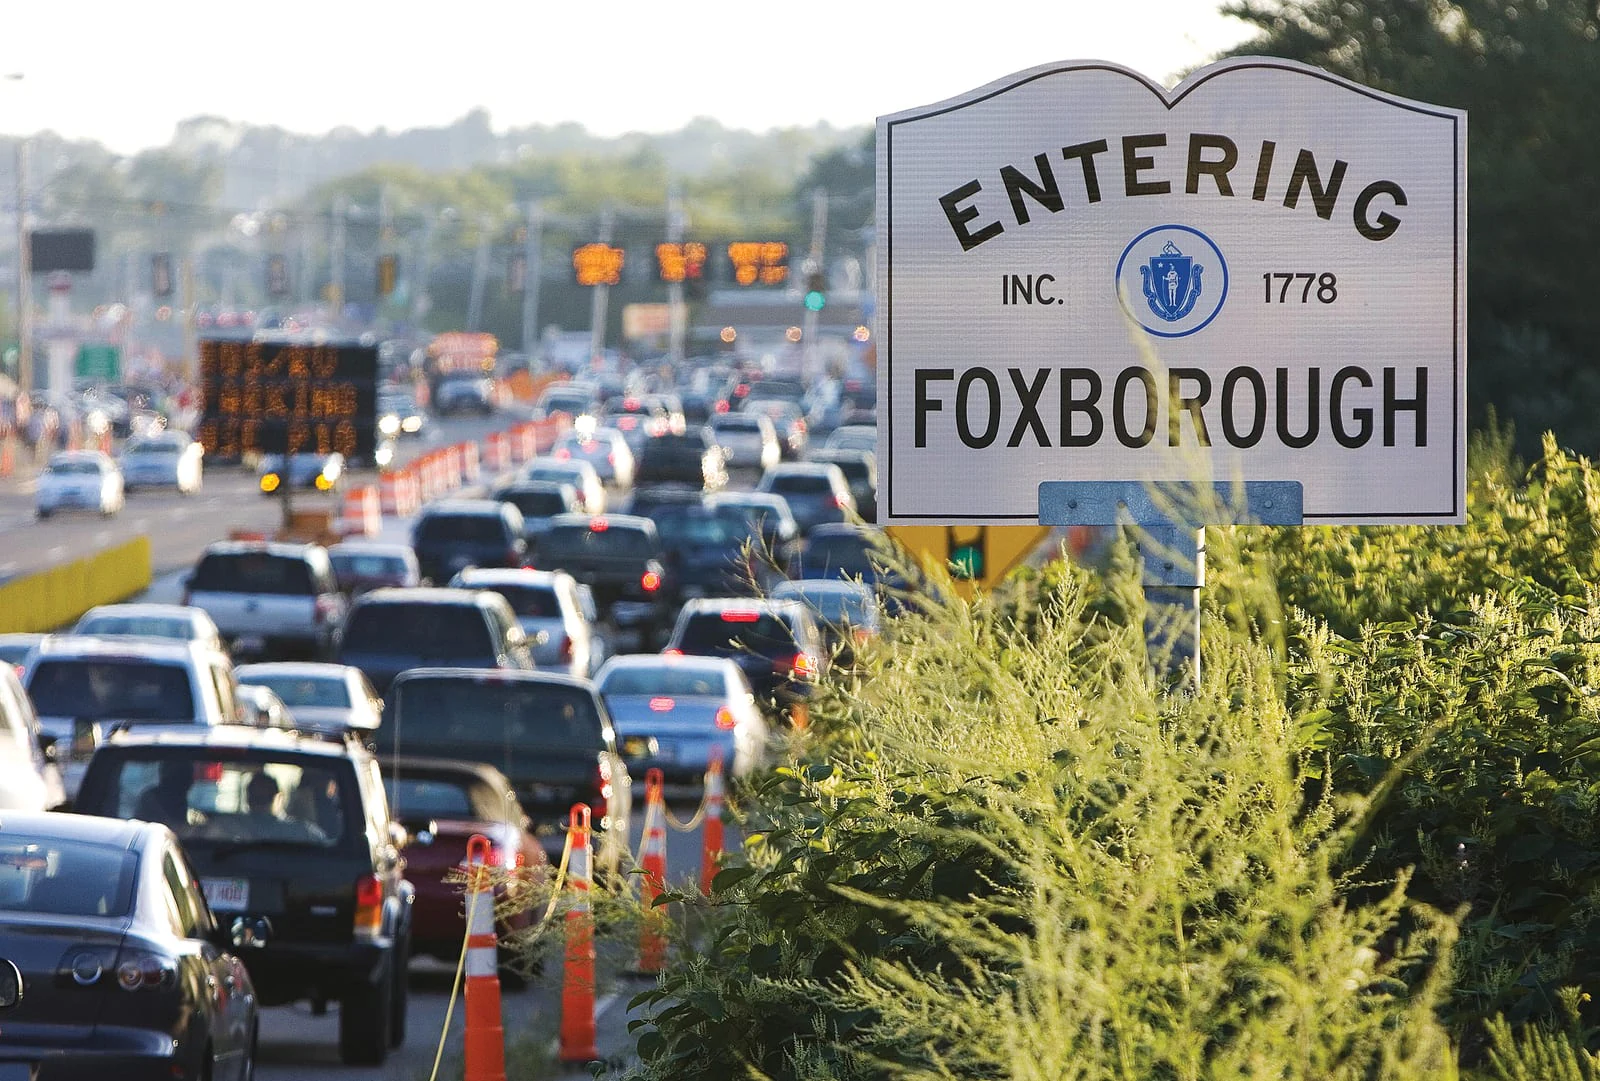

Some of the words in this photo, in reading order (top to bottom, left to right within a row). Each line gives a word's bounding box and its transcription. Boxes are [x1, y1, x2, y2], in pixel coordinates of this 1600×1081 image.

[939, 133, 1408, 252] ENTERING
[1002, 274, 1064, 305] INC.
[1263, 272, 1337, 304] 1778
[914, 366, 1428, 449] FOXBOROUGH
